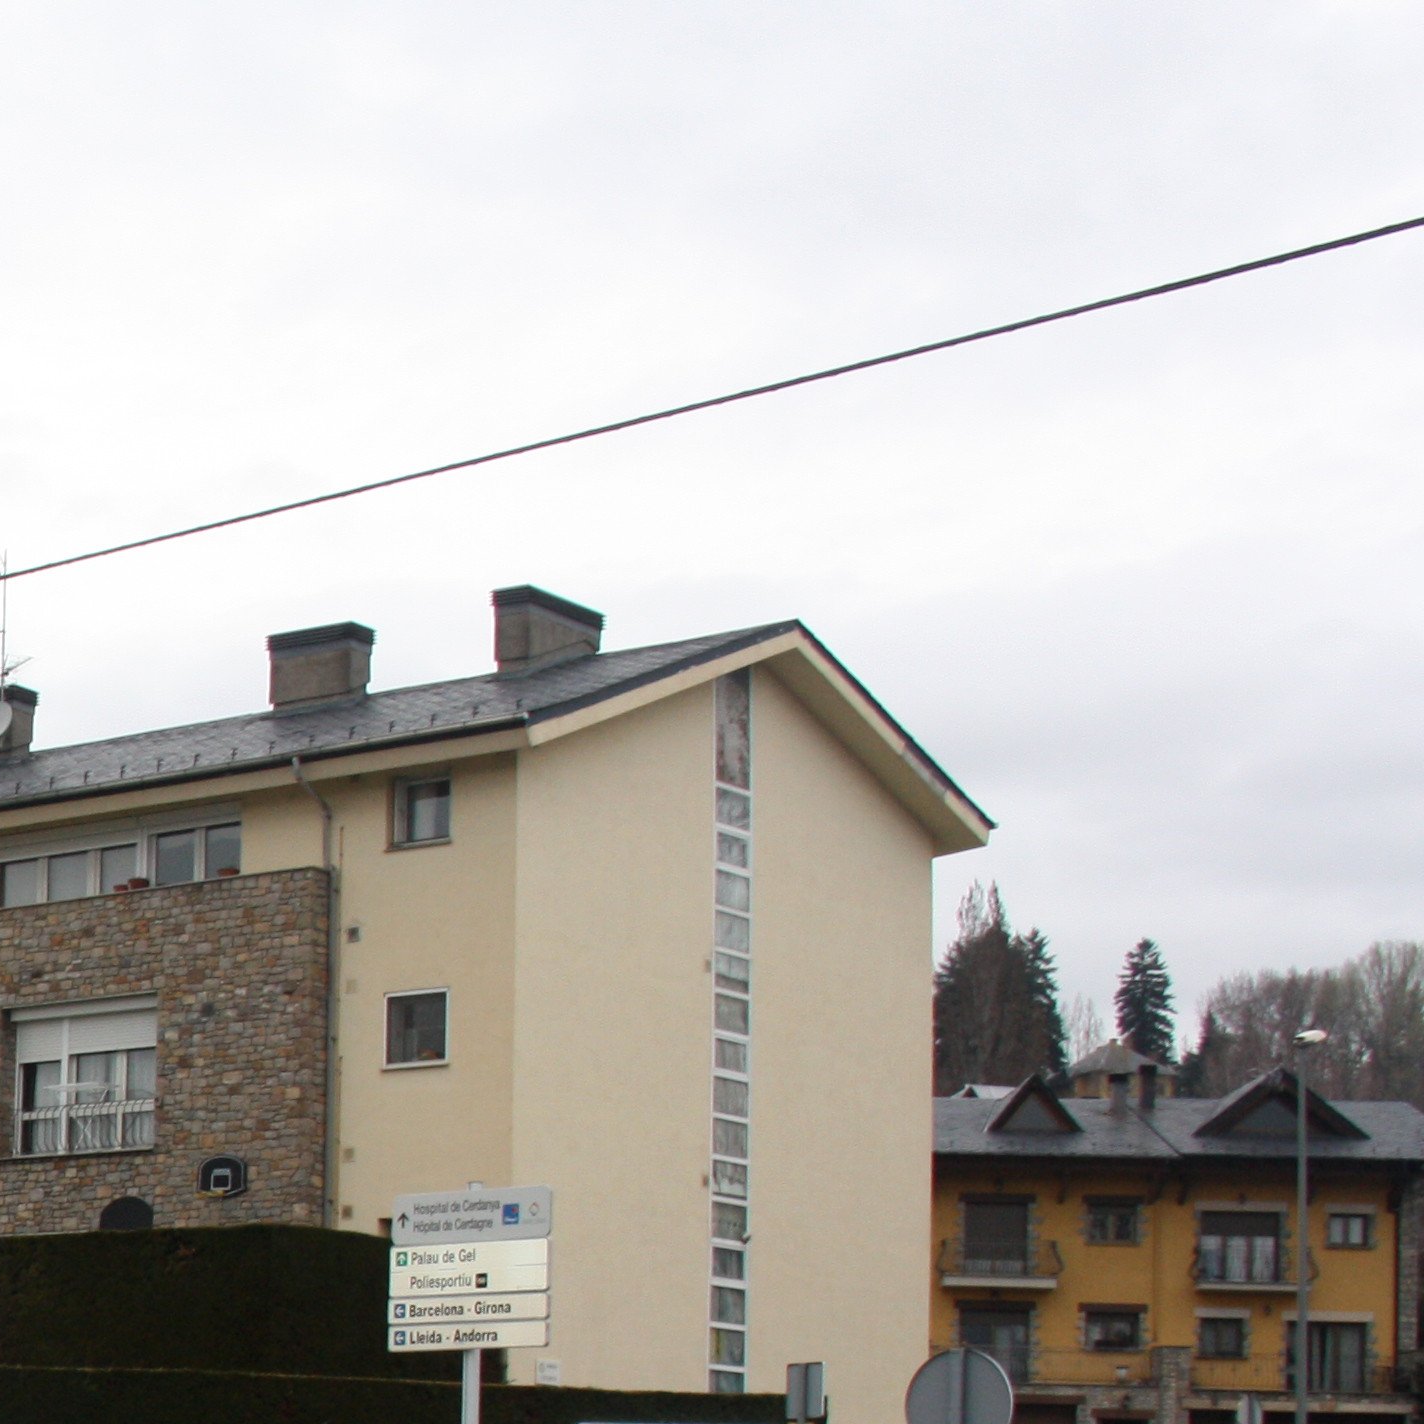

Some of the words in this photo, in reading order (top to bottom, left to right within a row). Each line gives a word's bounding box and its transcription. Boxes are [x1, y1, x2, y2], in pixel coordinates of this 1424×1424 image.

[413, 1202, 448, 1216] Hospital
[450, 1201, 461, 1213] de
[442, 1219, 452, 1231] de
[411, 1251, 439, 1265] Palau
[443, 1250, 455, 1263] de
[458, 1248, 476, 1262] Gel
[410, 1273, 472, 1291] Poliesportiu
[409, 1302, 464, 1317] Barcelona
[474, 1301, 511, 1315] Girona
[409, 1330, 442, 1344] Lleida
[453, 1328, 498, 1342] Andorra
